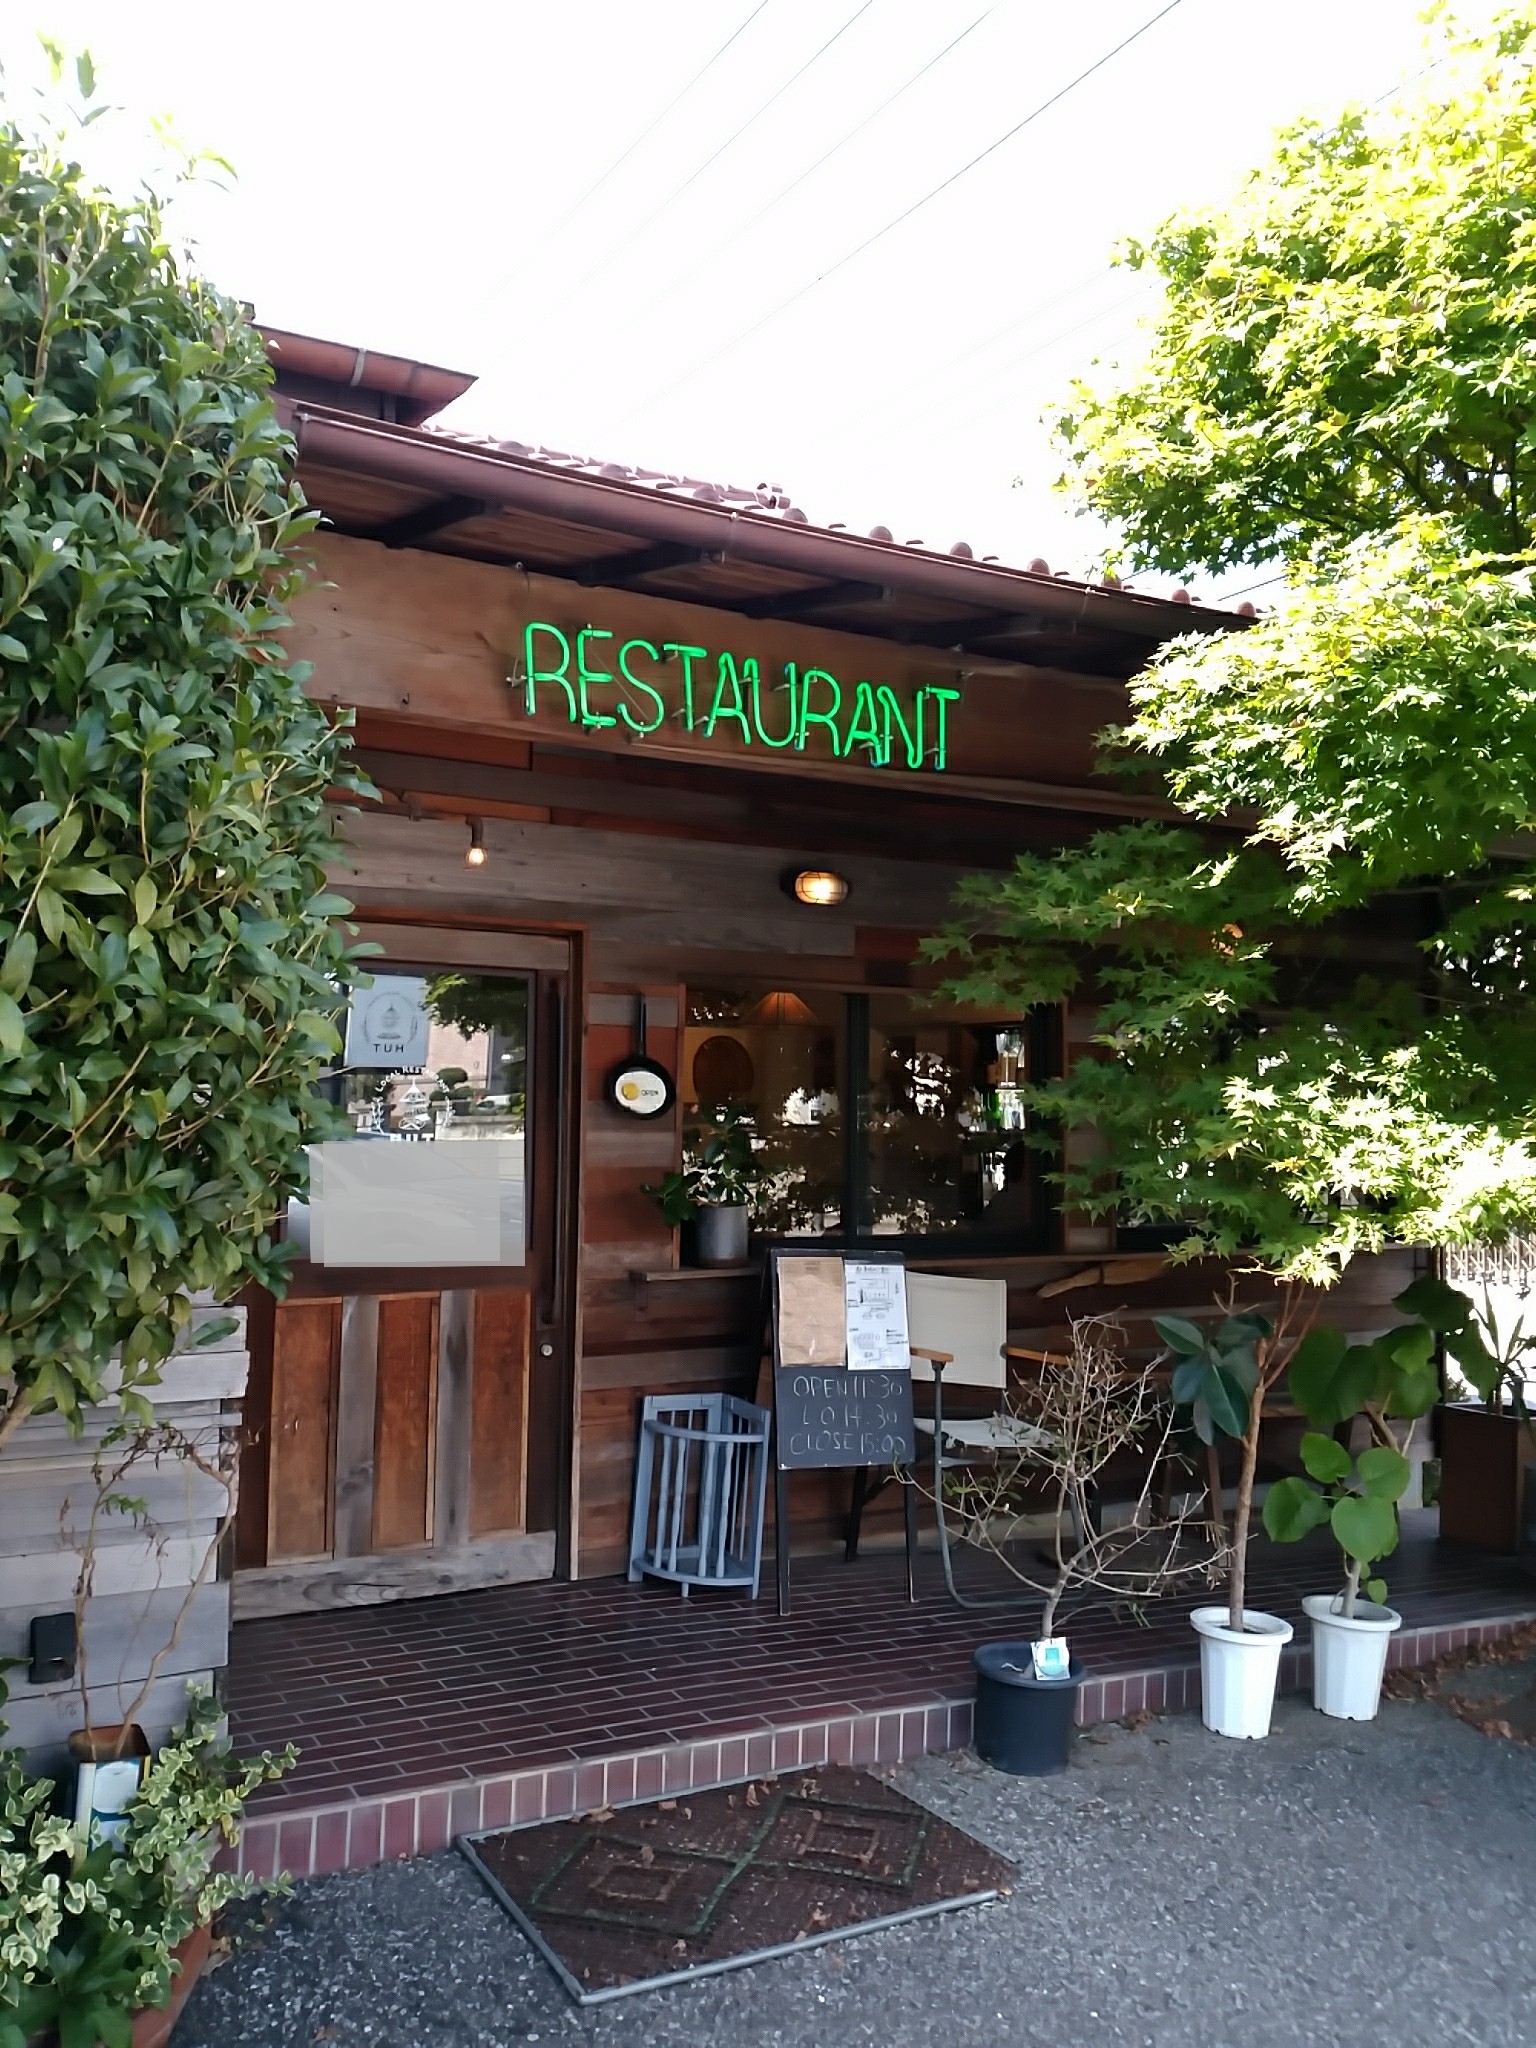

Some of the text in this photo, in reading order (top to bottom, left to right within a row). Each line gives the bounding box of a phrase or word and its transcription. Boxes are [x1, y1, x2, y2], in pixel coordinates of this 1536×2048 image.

[525, 622, 960, 770] RESTAURANT
[375, 1069, 401, 1092] LOCAL
[793, 1375, 848, 1399] OPEN
[790, 1430, 906, 1455] CLOSE 15:00
